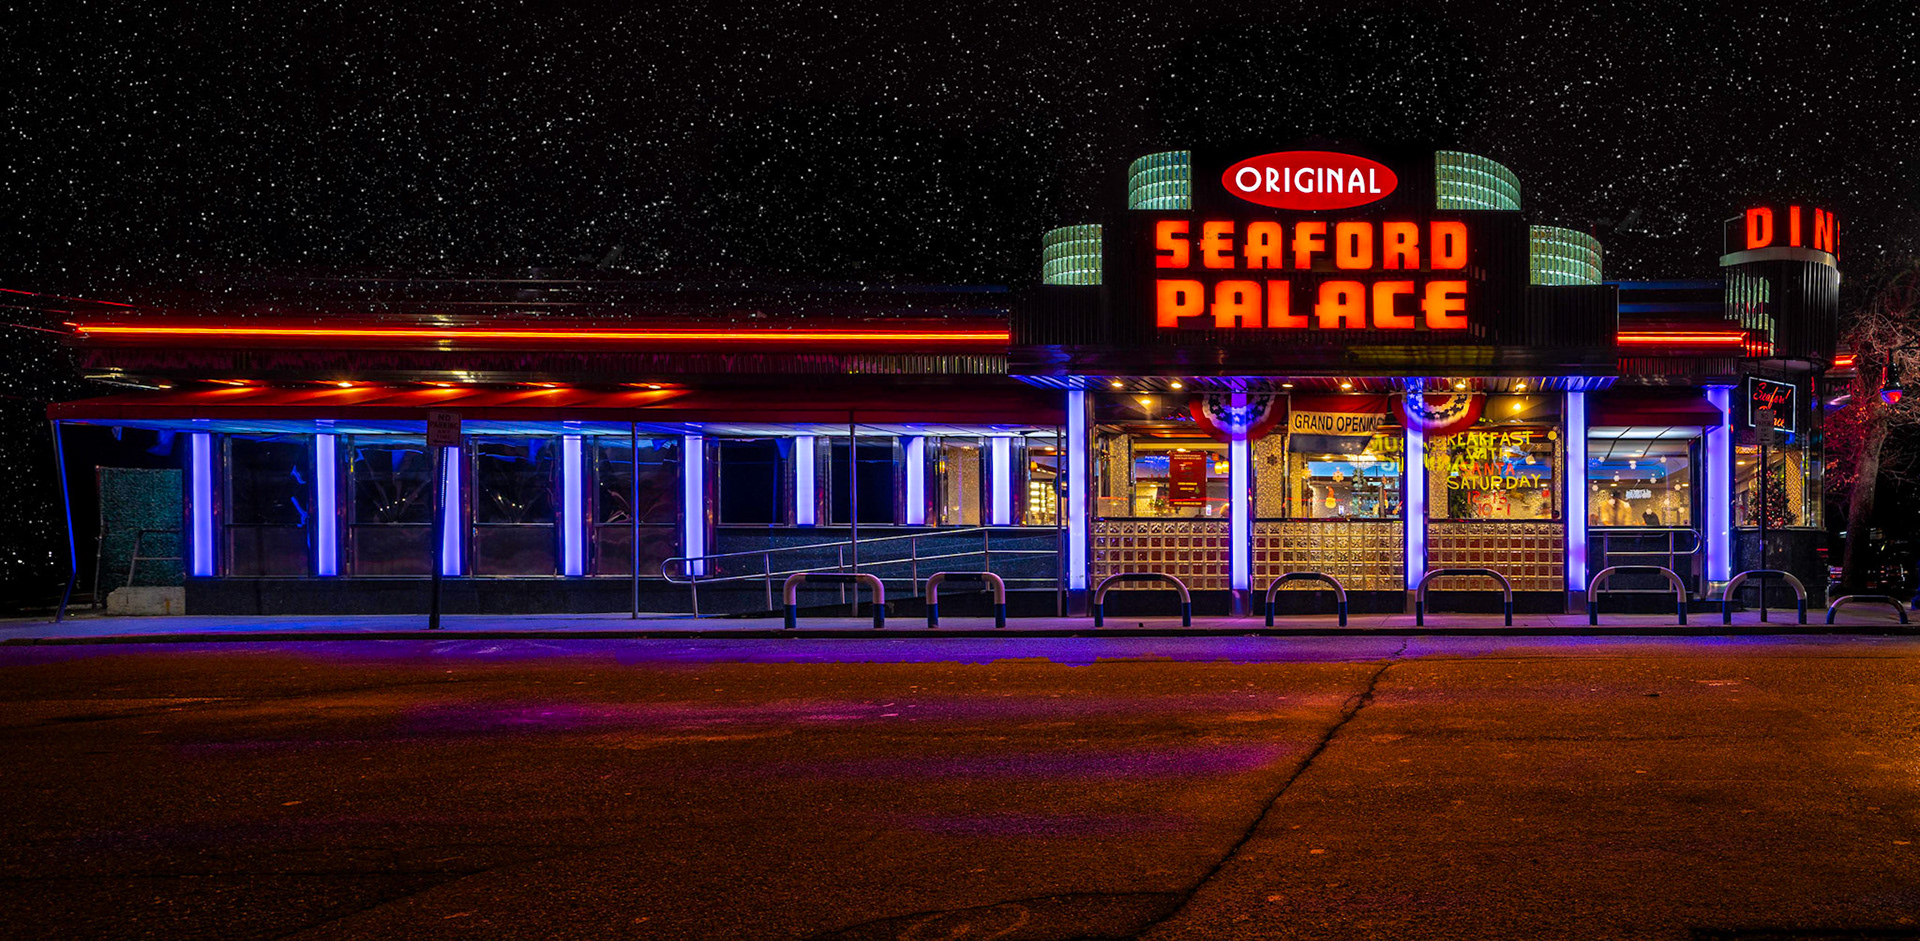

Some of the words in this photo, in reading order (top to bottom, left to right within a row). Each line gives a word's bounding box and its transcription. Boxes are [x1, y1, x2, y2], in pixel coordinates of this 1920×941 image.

[1235, 167, 1381, 193] ORIGINAL
[1746, 205, 1841, 262] DIN
[1155, 220, 1468, 270] SEAFORD
[1155, 279, 1468, 329] PALACE
[429, 421, 459, 430] PARKING
[1294, 414, 1333, 430] GRAND
[1447, 431, 1534, 447] REAKFAST
[1459, 461, 1516, 476] SANTA
[1447, 473, 1541, 490] SATURDAY
